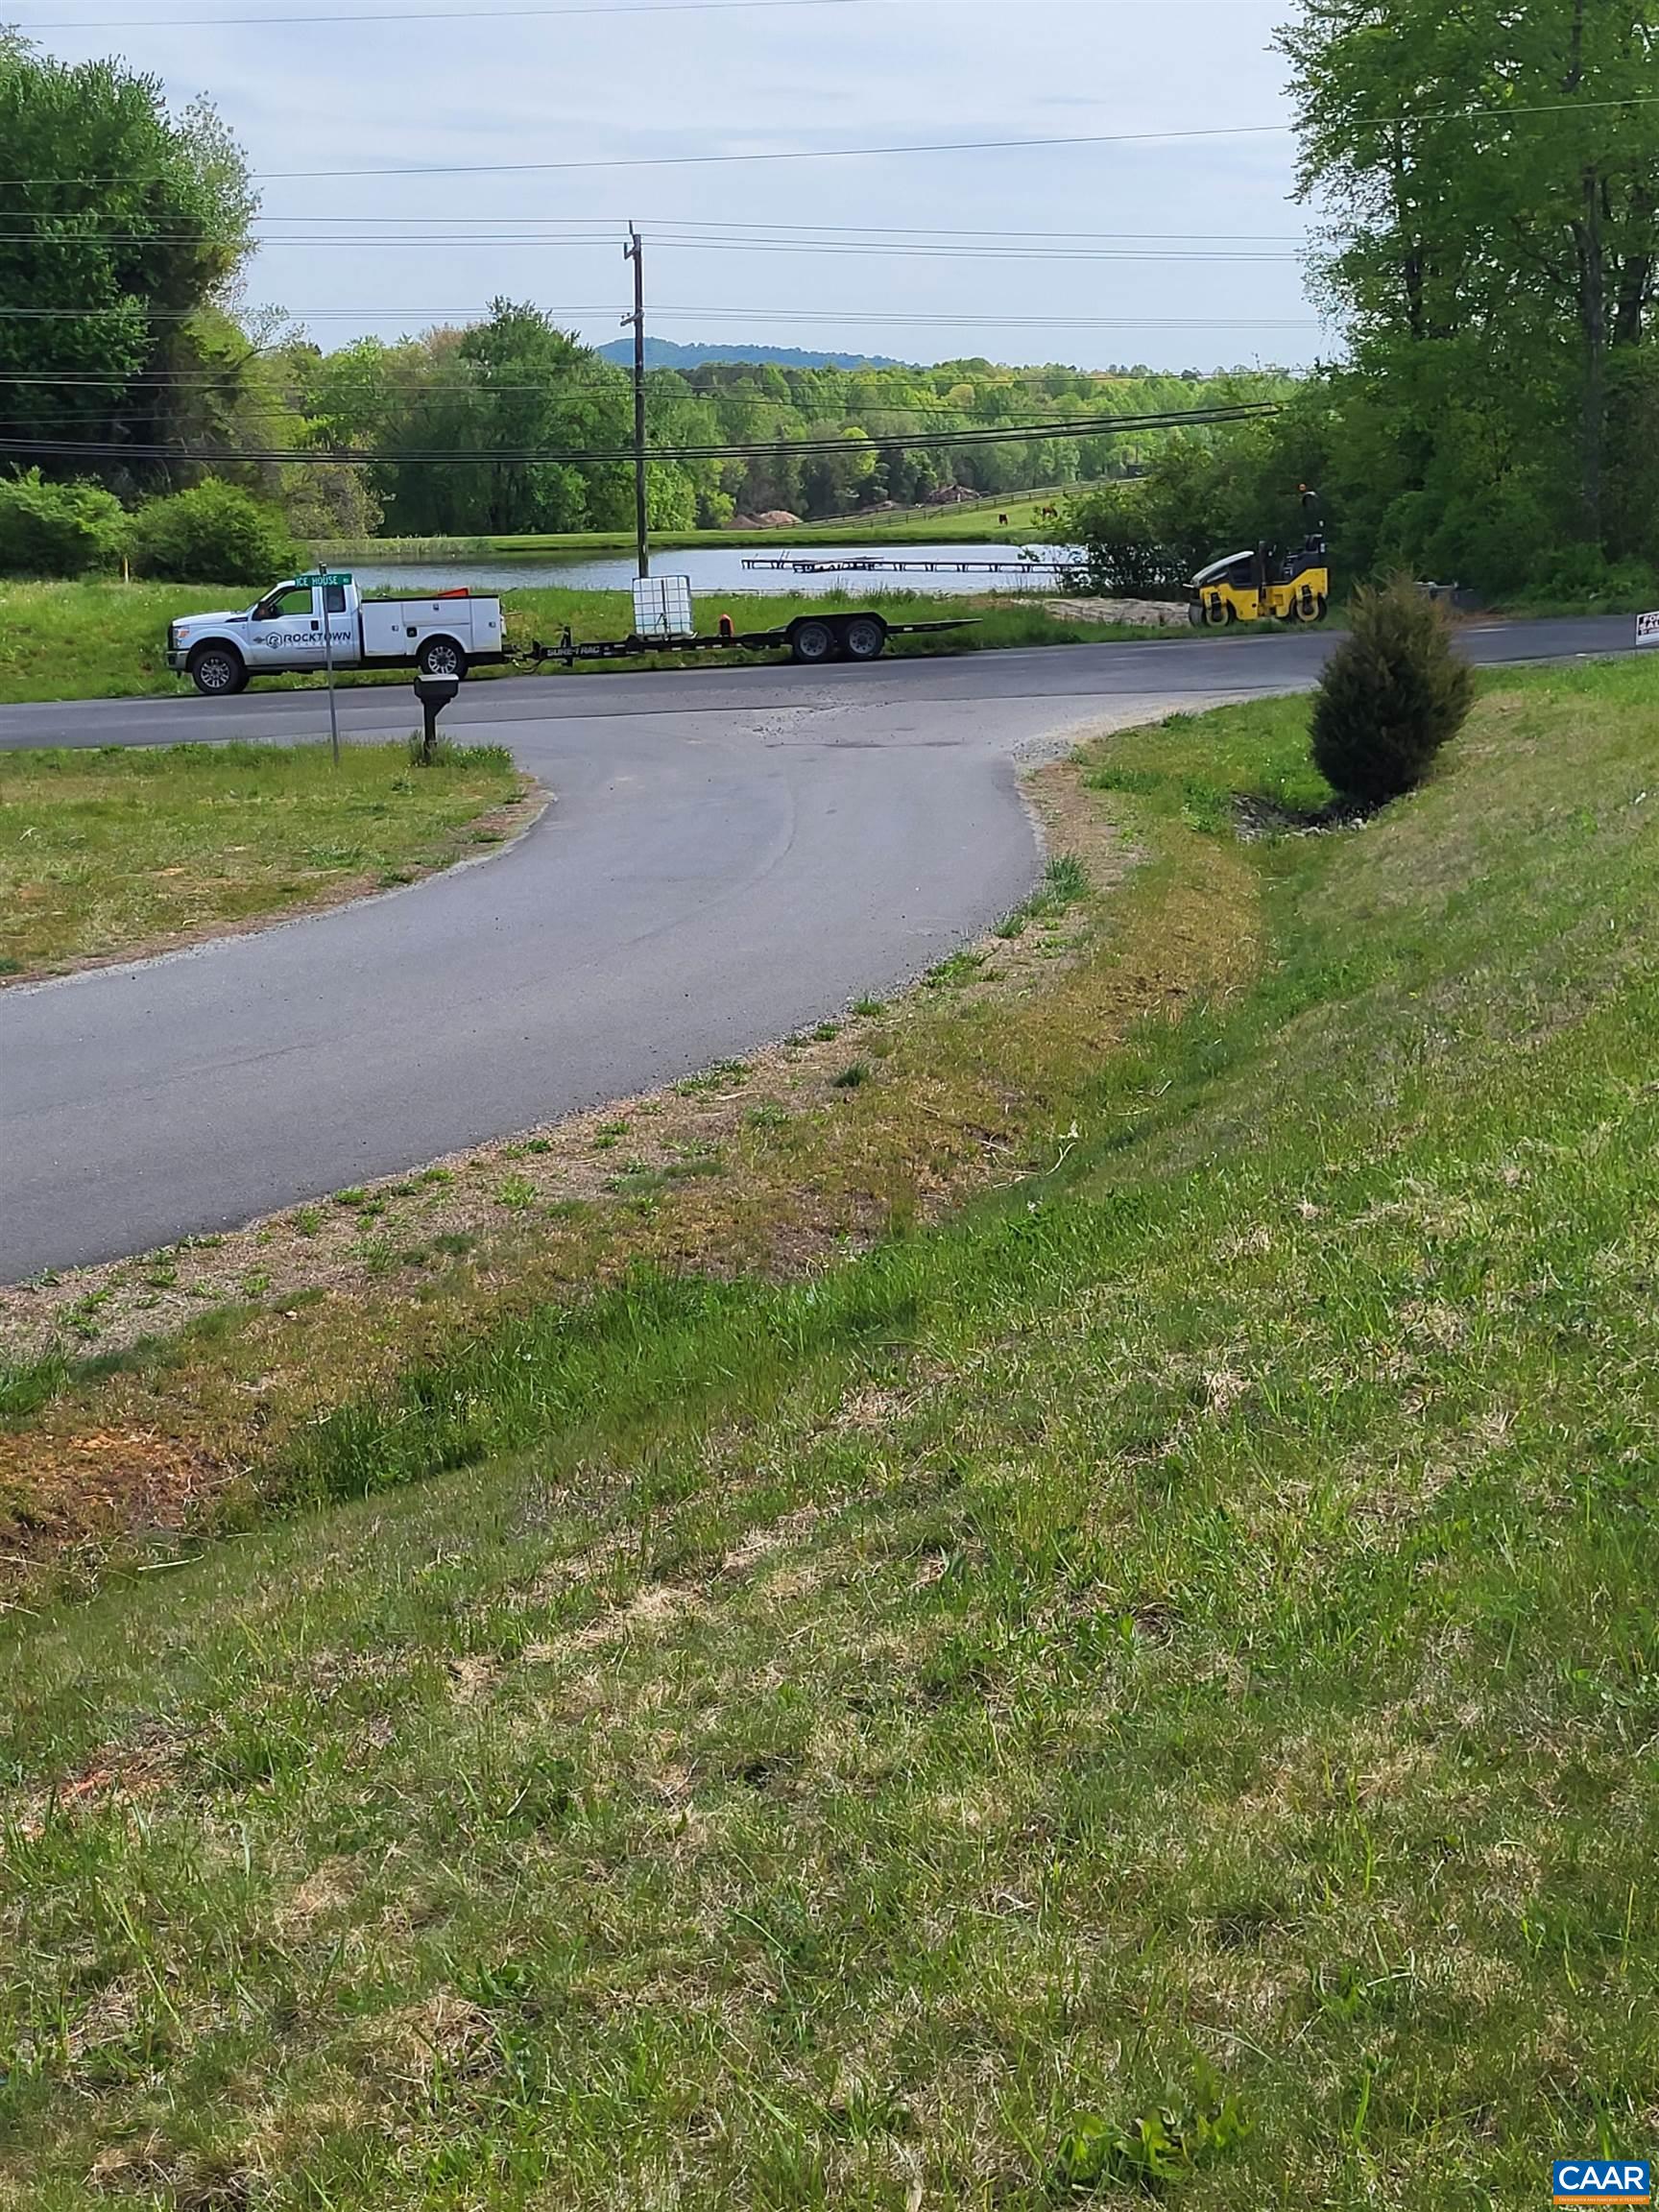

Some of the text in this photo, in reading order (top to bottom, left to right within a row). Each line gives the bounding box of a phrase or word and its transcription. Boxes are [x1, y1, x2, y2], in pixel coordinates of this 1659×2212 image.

[296, 576, 308, 588] ICE
[312, 575, 338, 586] HOUSE
[283, 632, 351, 642] ROCKTOWN
